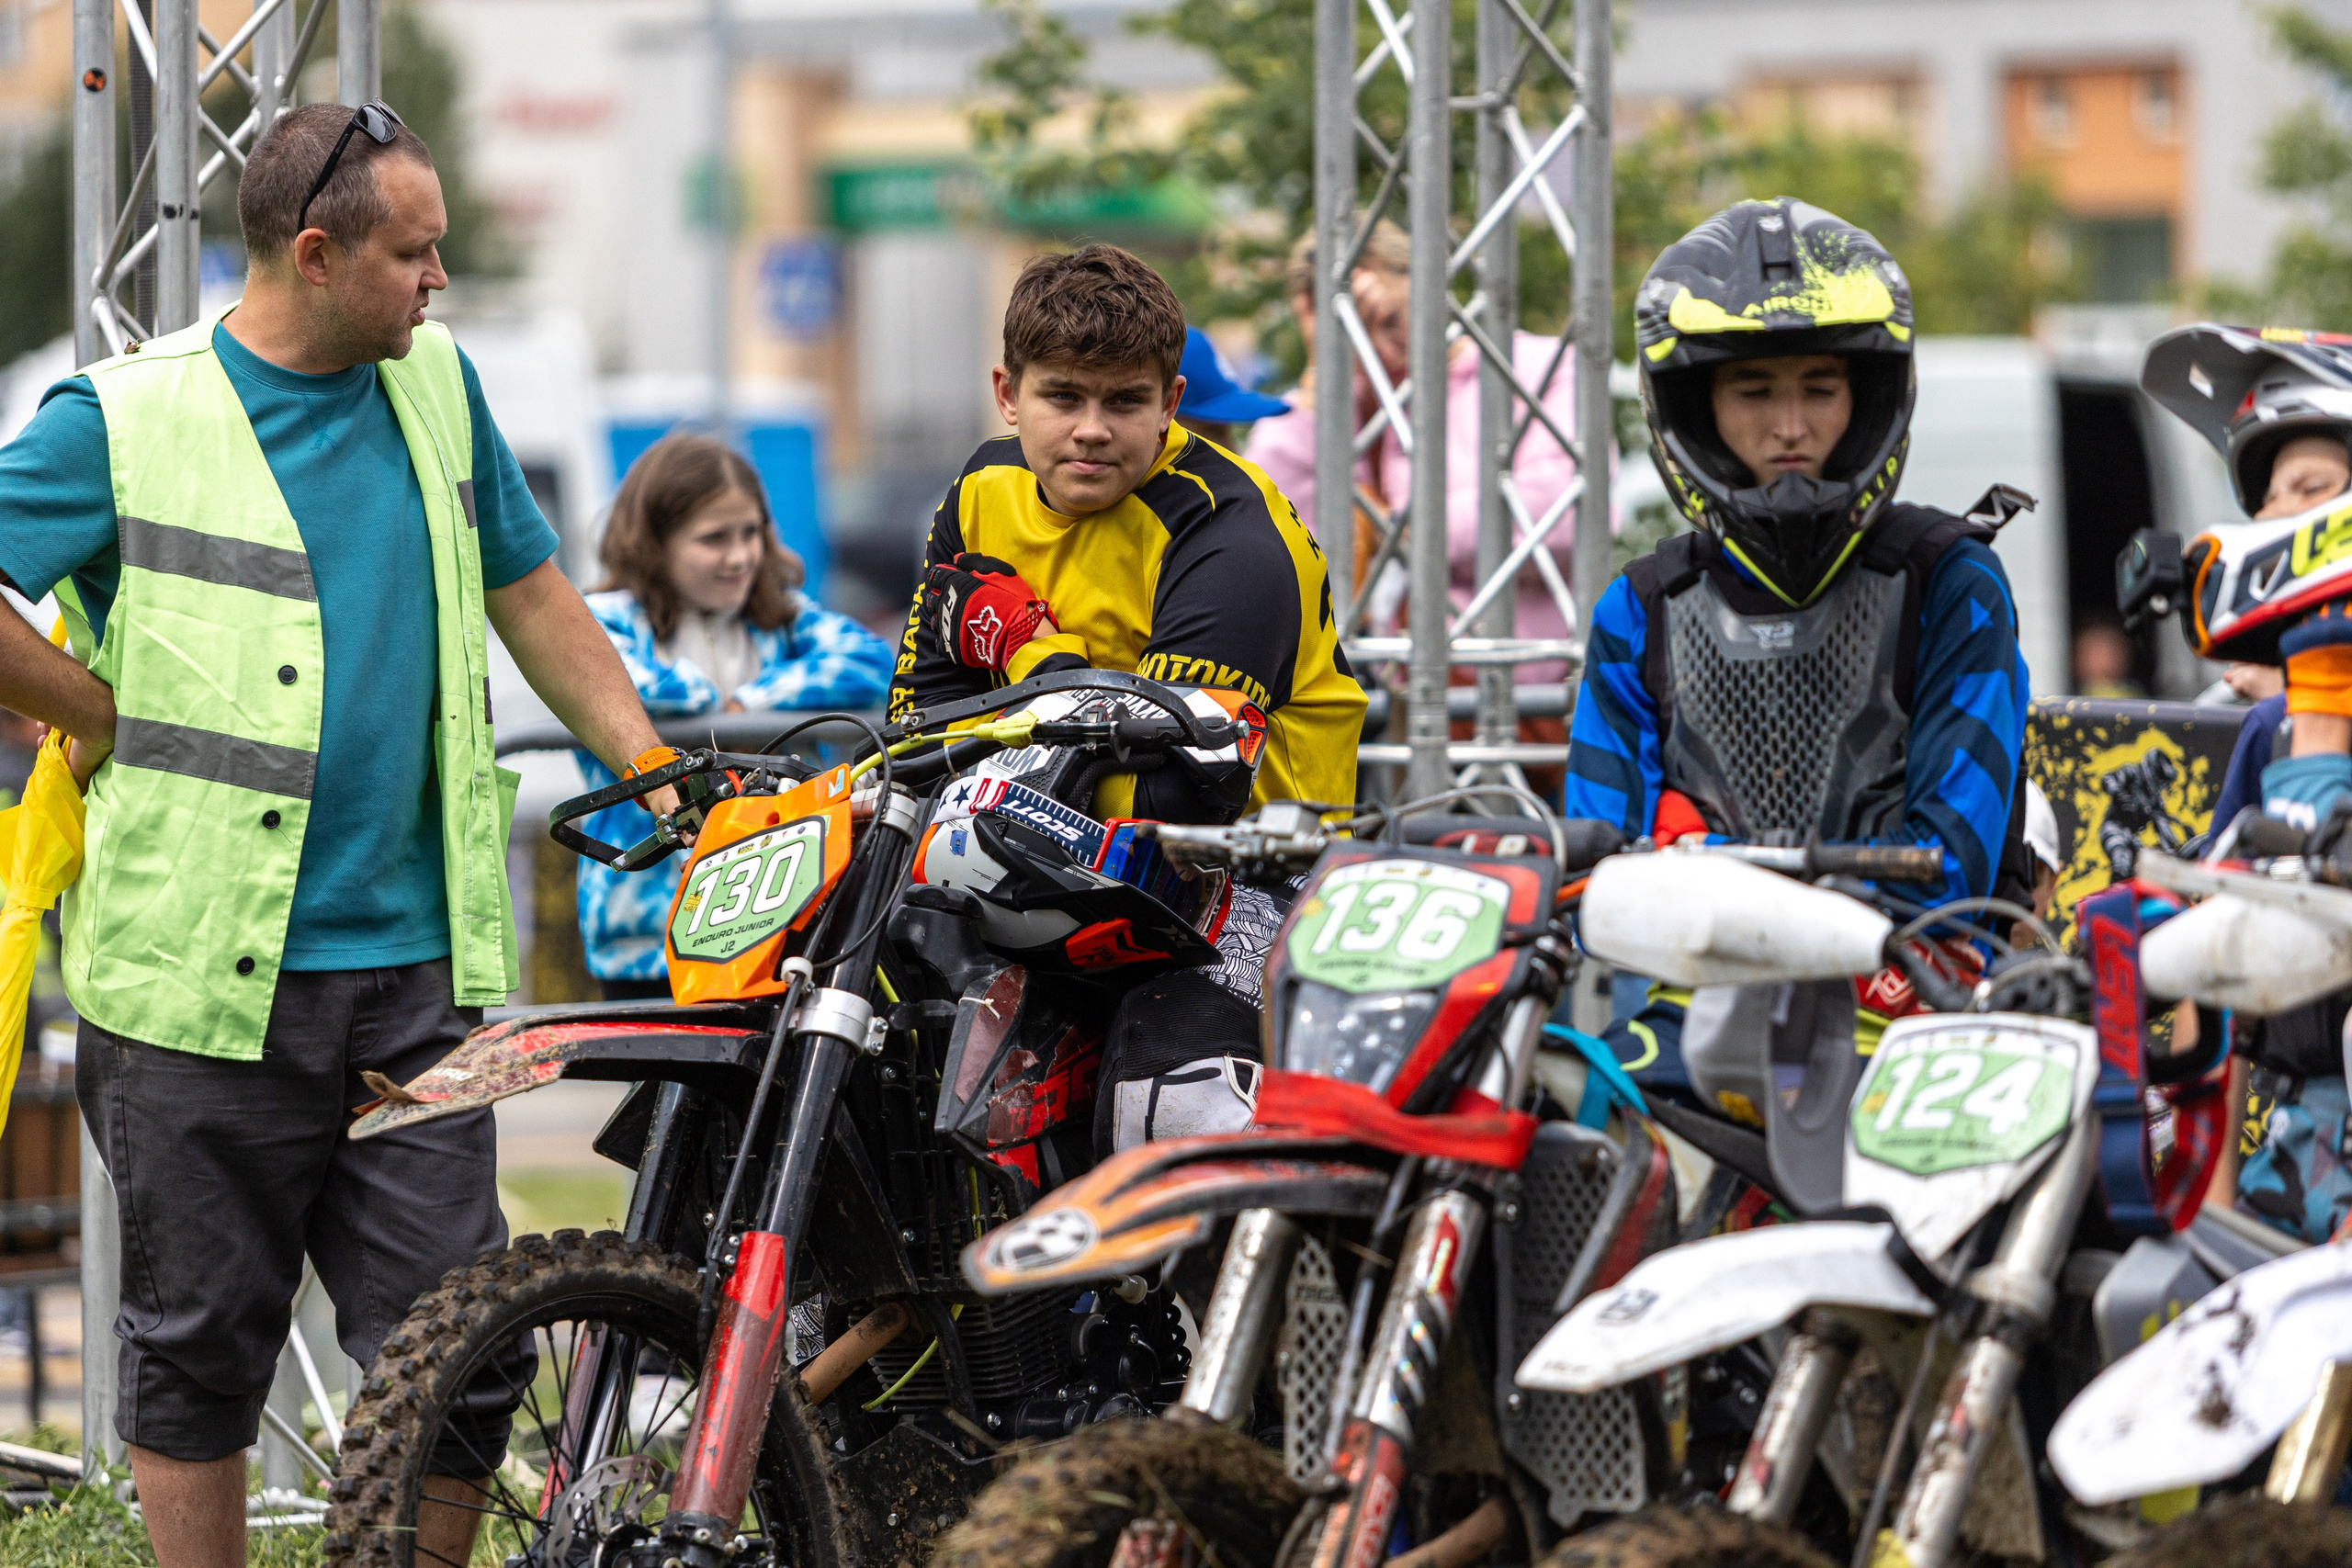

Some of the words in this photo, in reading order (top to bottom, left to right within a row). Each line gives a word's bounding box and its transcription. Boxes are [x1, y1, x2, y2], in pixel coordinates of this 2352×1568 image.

[1001, 798, 1085, 841] SCOTT
[685, 840, 806, 937] 130
[692, 928, 733, 948] ENDURO
[734, 918, 775, 935] JUNIOR
[720, 941, 736, 953] J2
[1309, 879, 1484, 963] 136
[1873, 1049, 2043, 1134] 124
